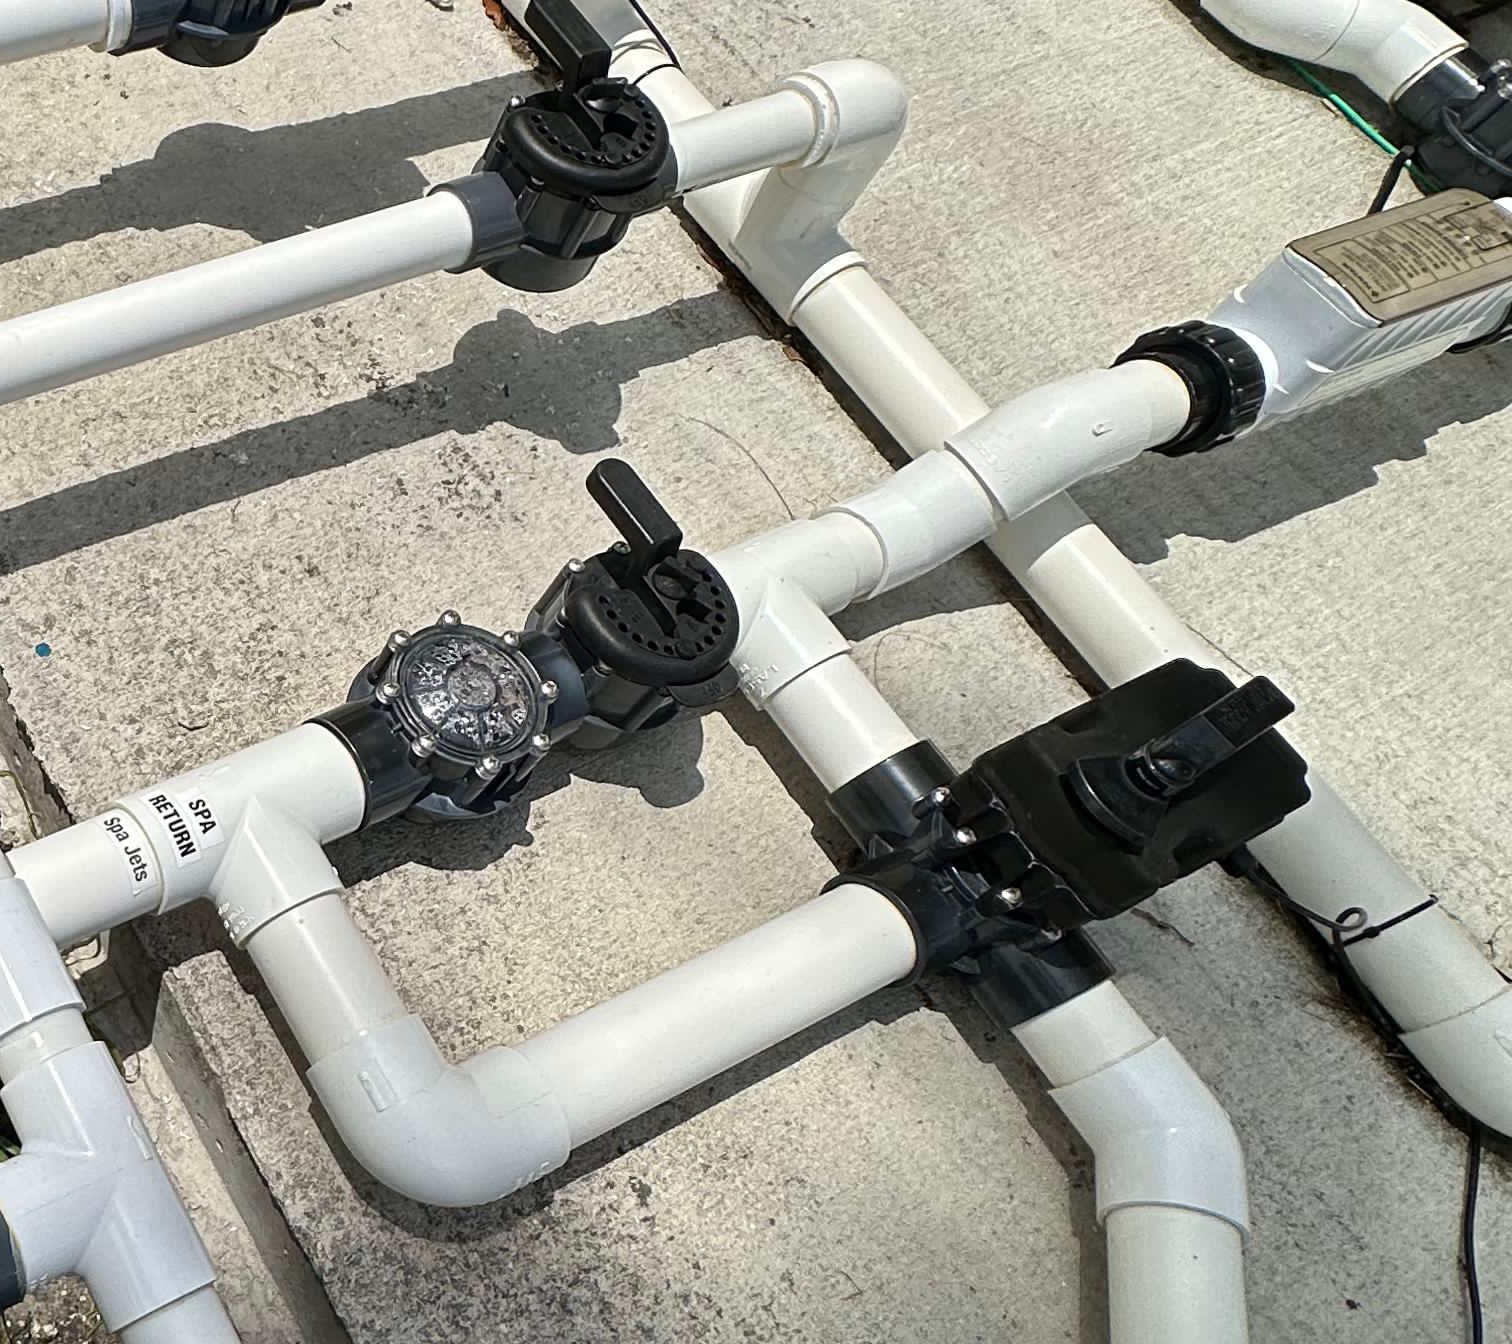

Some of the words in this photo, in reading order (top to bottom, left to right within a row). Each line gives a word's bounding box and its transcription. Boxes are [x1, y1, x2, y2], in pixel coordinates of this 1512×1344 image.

[148, 794, 196, 858] RETURN
[188, 799, 217, 834] SPA
[104, 816, 130, 842] Spa
[124, 845, 148, 882] Jets
